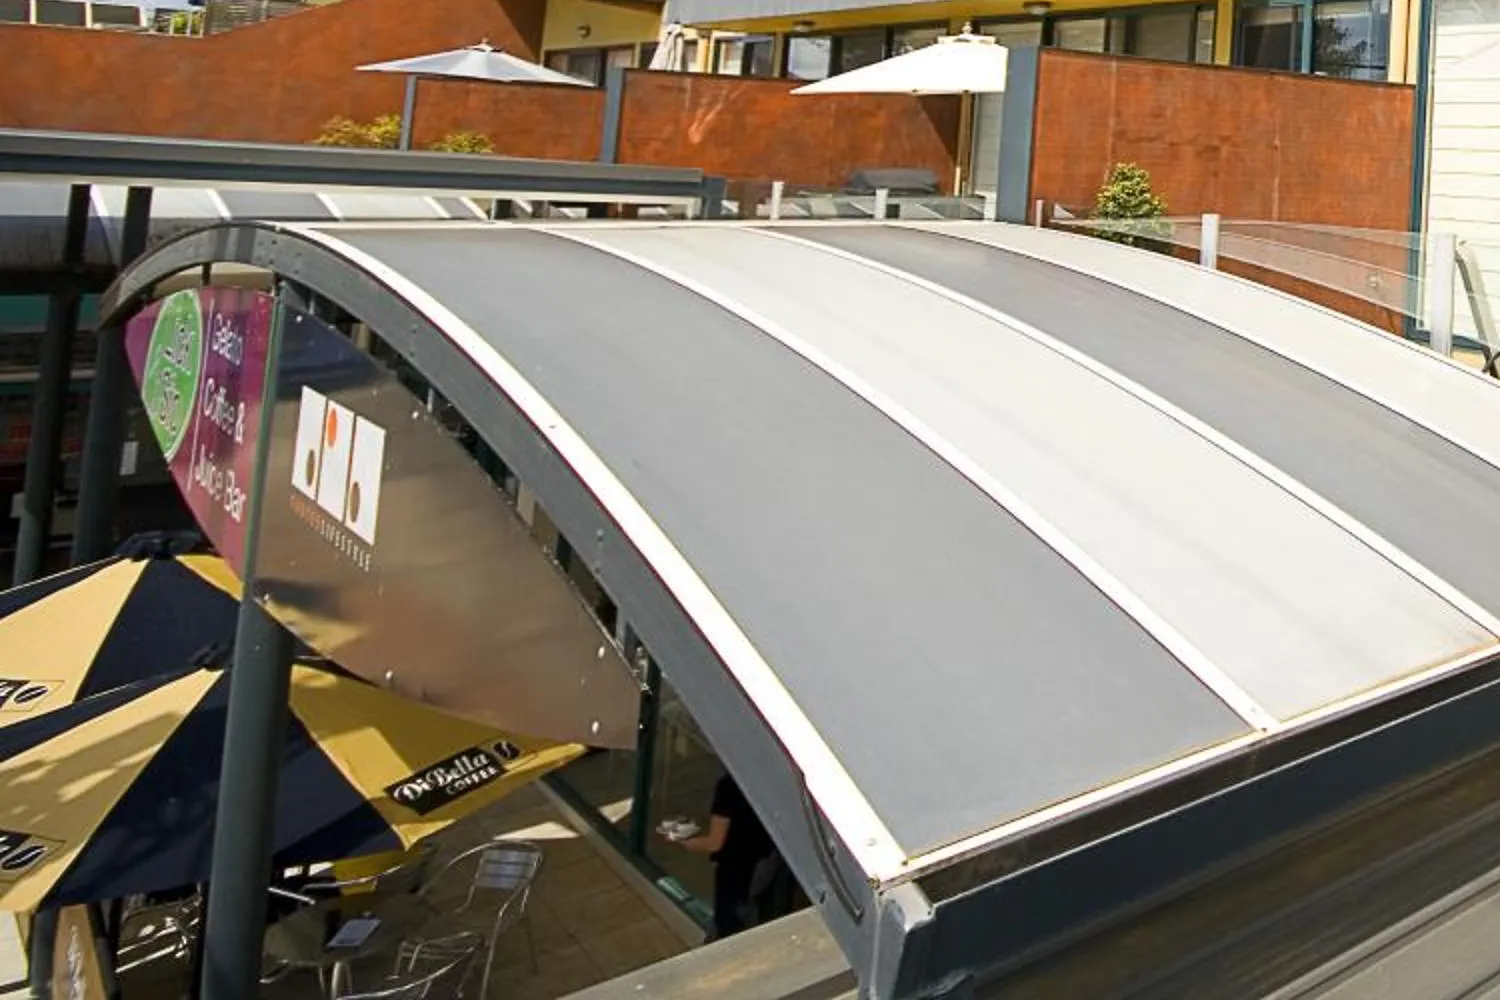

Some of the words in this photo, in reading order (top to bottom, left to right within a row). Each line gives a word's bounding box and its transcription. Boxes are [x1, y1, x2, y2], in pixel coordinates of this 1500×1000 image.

[203, 377, 235, 435] Coffee
[223, 469, 247, 523] Bar
[446, 765, 500, 796] COFFEE
